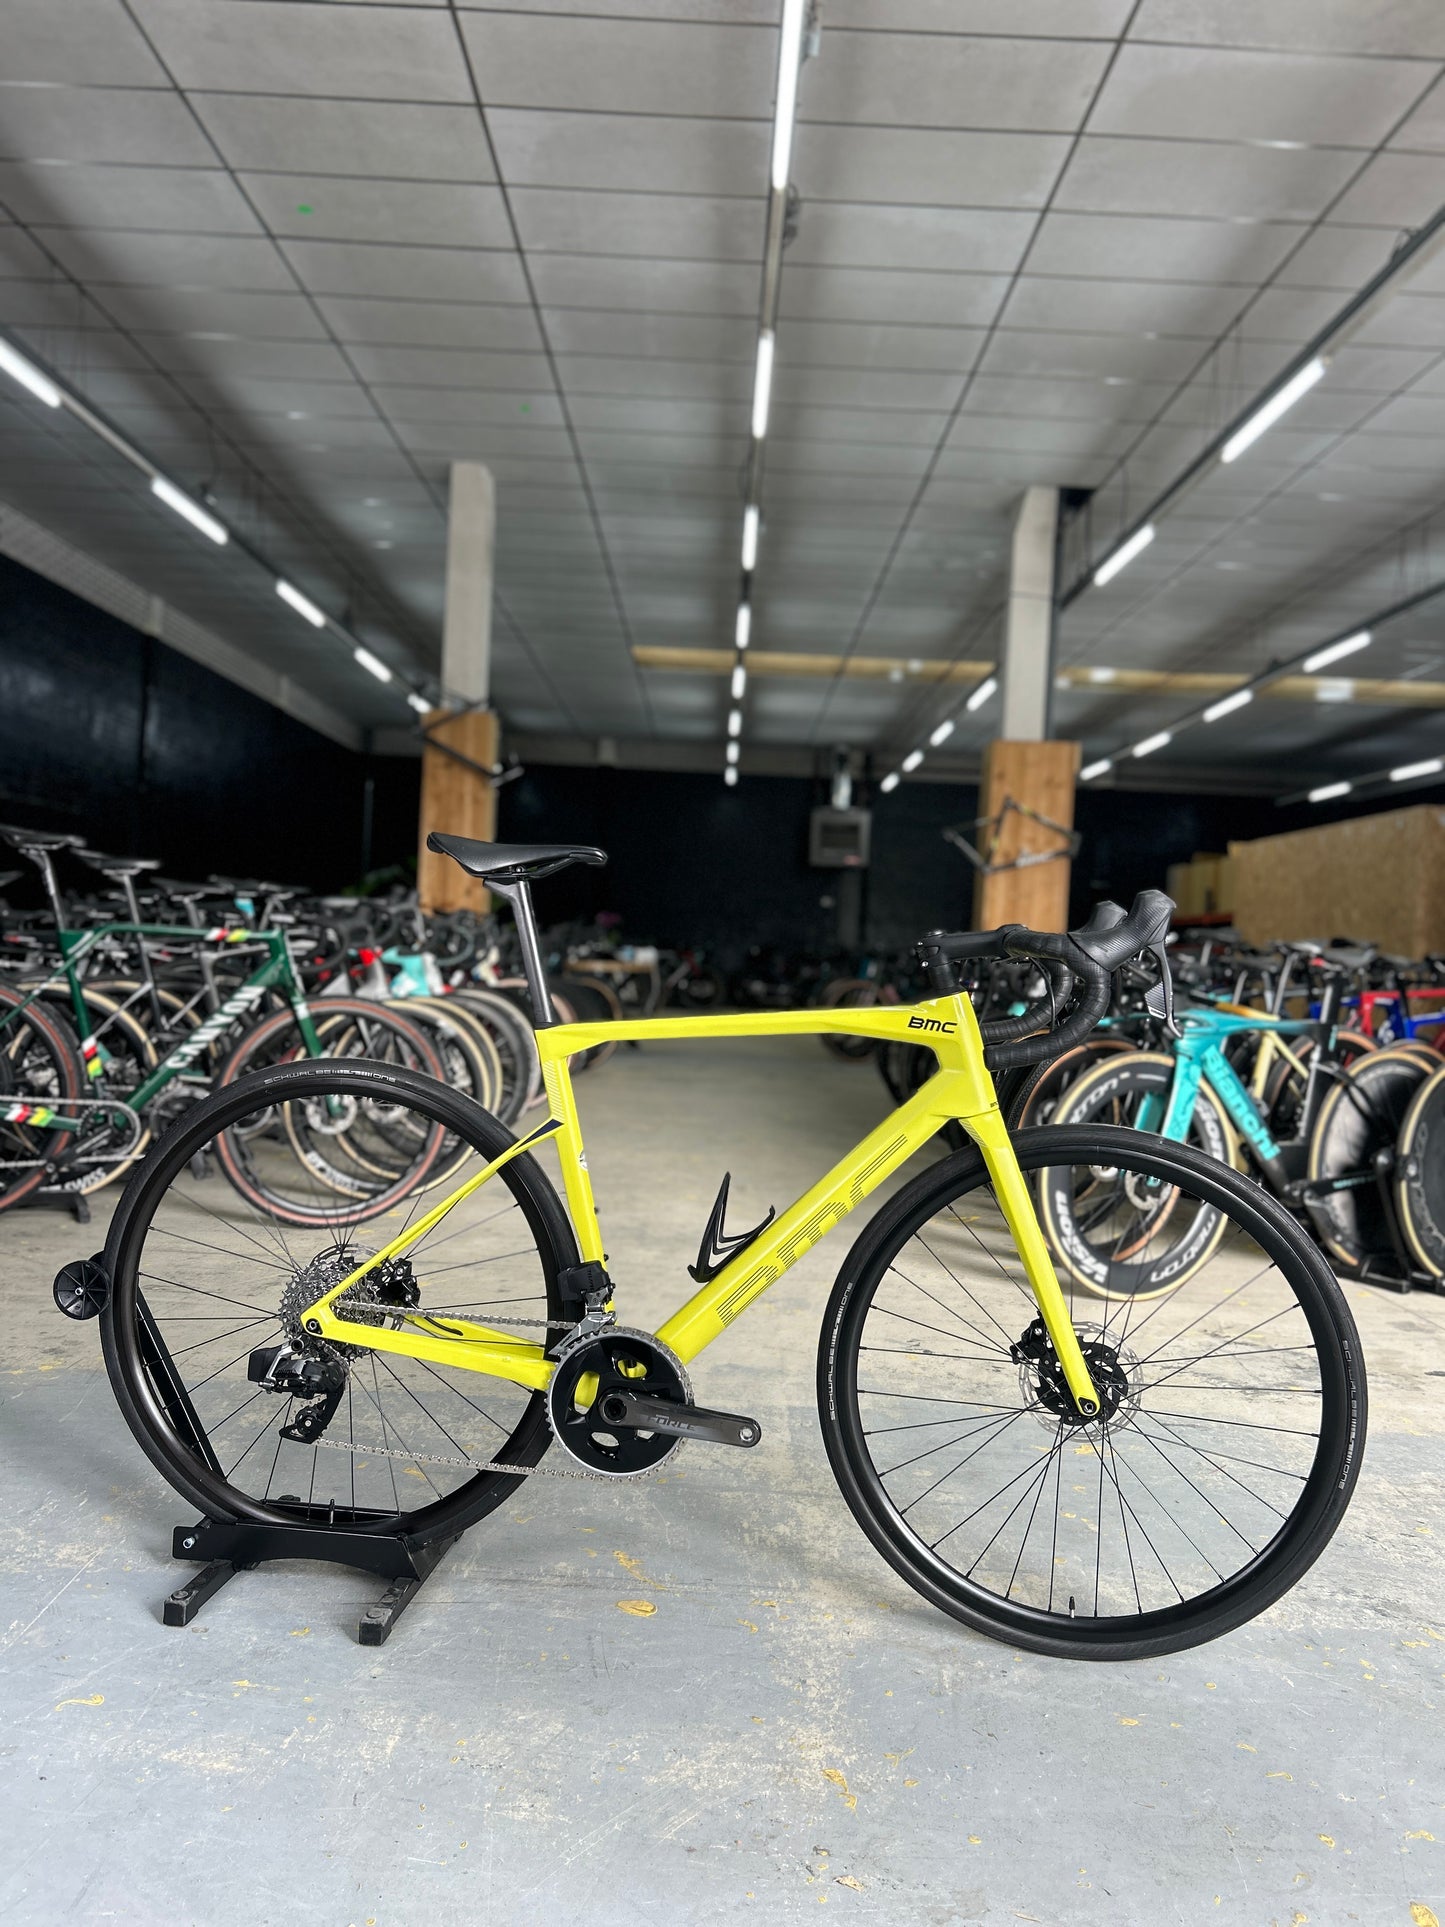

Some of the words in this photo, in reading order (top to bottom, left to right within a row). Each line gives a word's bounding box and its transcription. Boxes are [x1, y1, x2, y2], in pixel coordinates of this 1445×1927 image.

[907, 1016, 958, 1034] BMC
[263, 1069, 331, 1085] SCHWALBE
[716, 1133, 908, 1329] BMC
[827, 1348, 837, 1421] SCHWALBE
[650, 1415, 697, 1431] FORCE
